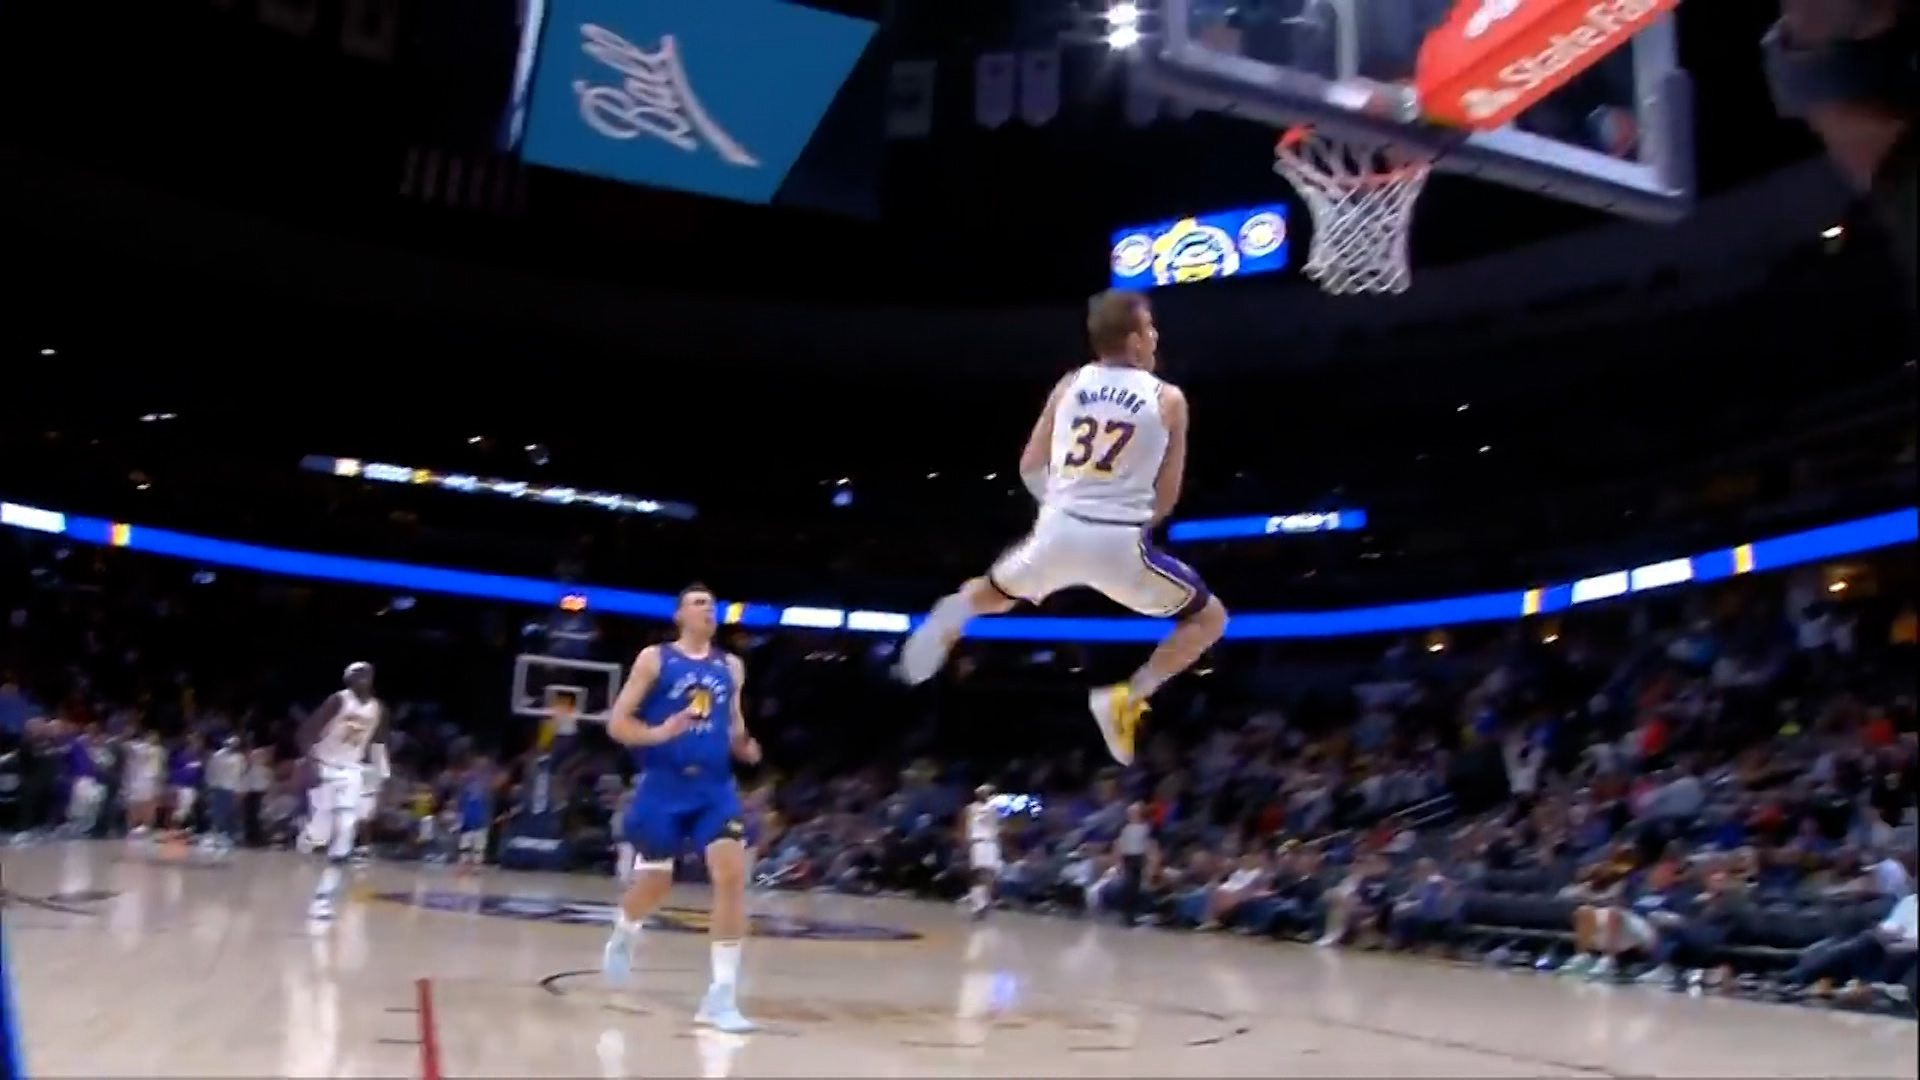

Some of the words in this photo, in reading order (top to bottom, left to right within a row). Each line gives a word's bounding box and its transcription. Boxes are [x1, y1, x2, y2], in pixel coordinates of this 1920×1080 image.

[1498, 27, 1607, 89] State
[572, 23, 760, 167] Ball
[1064, 415, 1136, 473] 37
